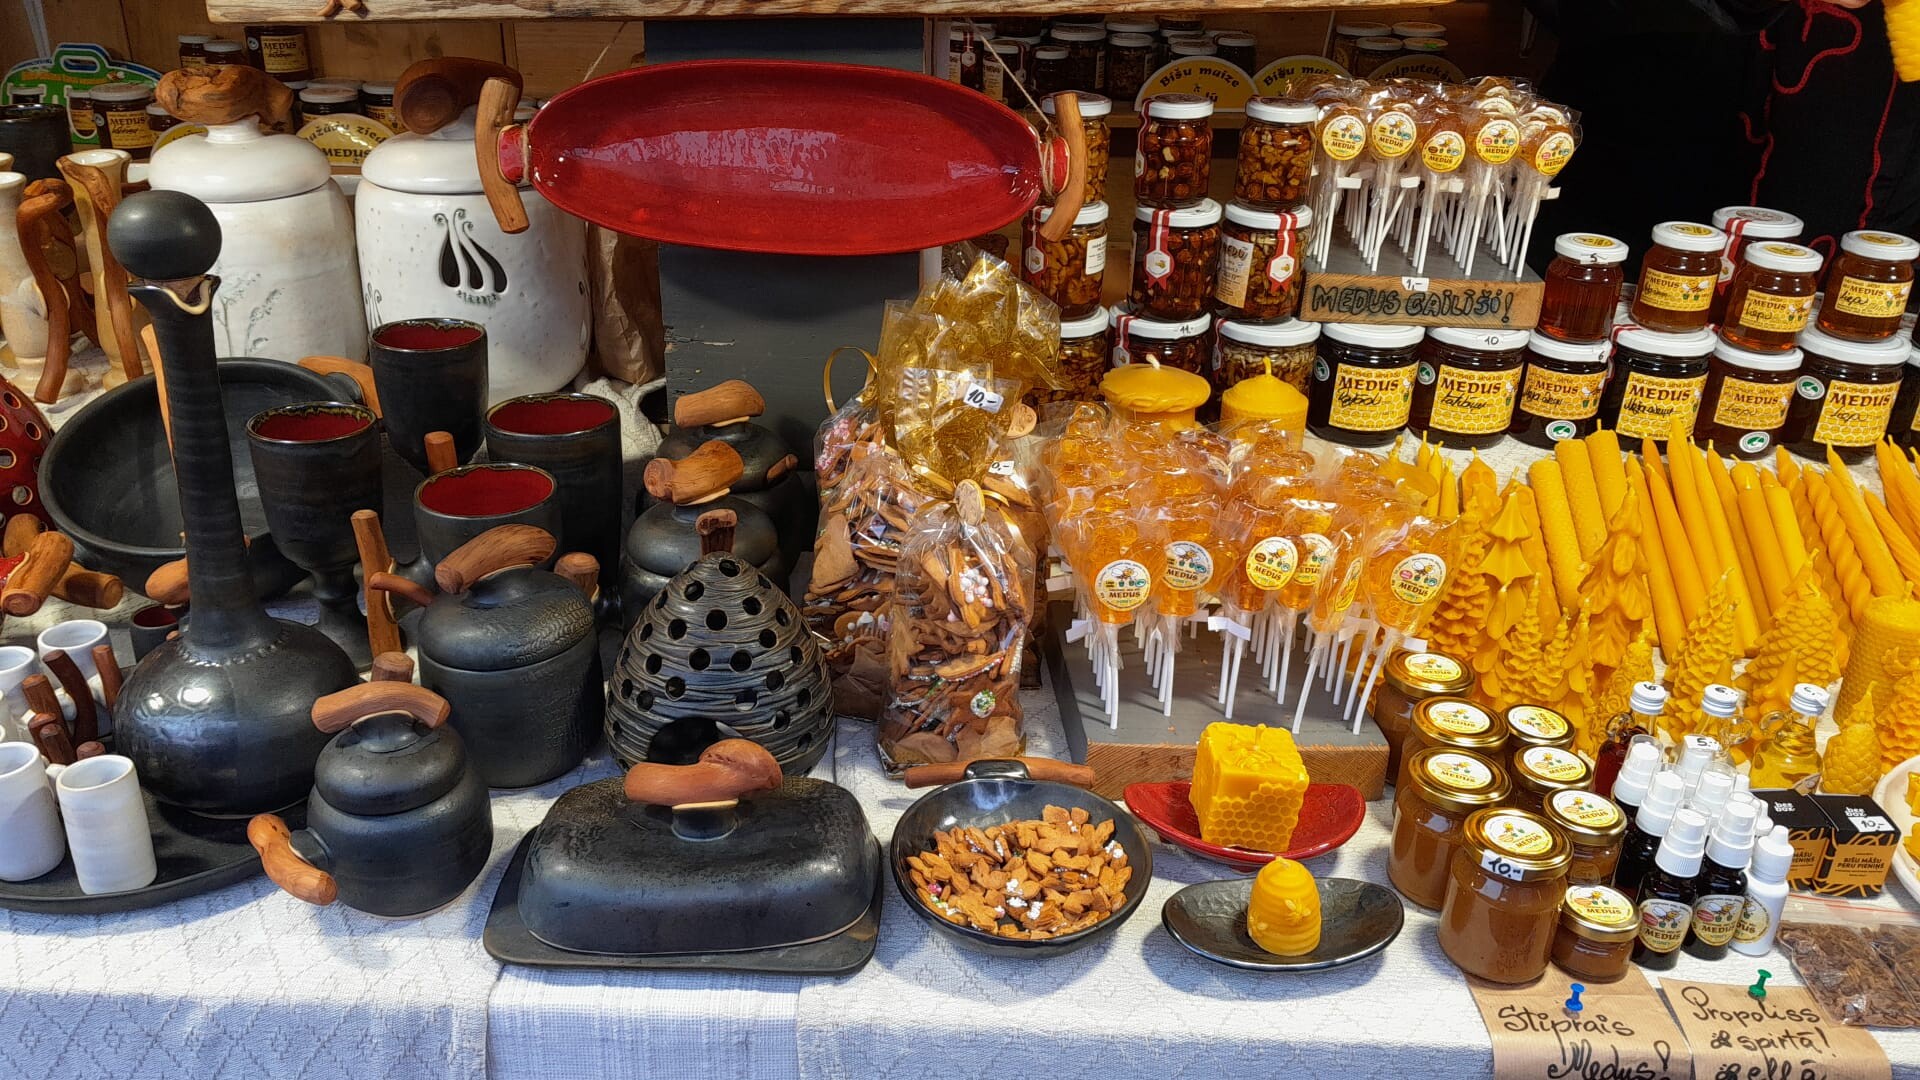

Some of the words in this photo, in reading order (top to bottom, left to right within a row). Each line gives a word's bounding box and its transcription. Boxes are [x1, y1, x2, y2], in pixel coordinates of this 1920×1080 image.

[263, 42, 297, 50] MEDUS
[1160, 67, 1192, 87] Bišu
[1200, 67, 1240, 88] maize
[110, 117, 146, 126] MEDUS
[321, 148, 371, 158] MEDUS
[1650, 277, 1680, 288] MEDUS
[1850, 286, 1884, 296] MEDUS
[1311, 284, 1400, 316] MEDUS
[1752, 299, 1787, 310] MEDUS
[1339, 375, 1399, 392] MEDUS
[1440, 377, 1502, 395] MEDUS
[1534, 380, 1579, 395] MEDUS
[1629, 384, 1691, 402] MEDUS
[1734, 393, 1779, 405] MEDUS
[1829, 392, 1891, 407] MEDUS
[1166, 569, 1198, 580] MEDUS
[1254, 565, 1282, 581] MEDUS
[1399, 582, 1429, 597] MEDUS
[1579, 811, 1609, 819] MEDUS
[1515, 834, 1543, 848] MEDUS
[1645, 929, 1681, 940] MEDUS
[1681, 986, 1821, 1028] Propoliss
[1498, 1004, 1636, 1066] Stiprais
